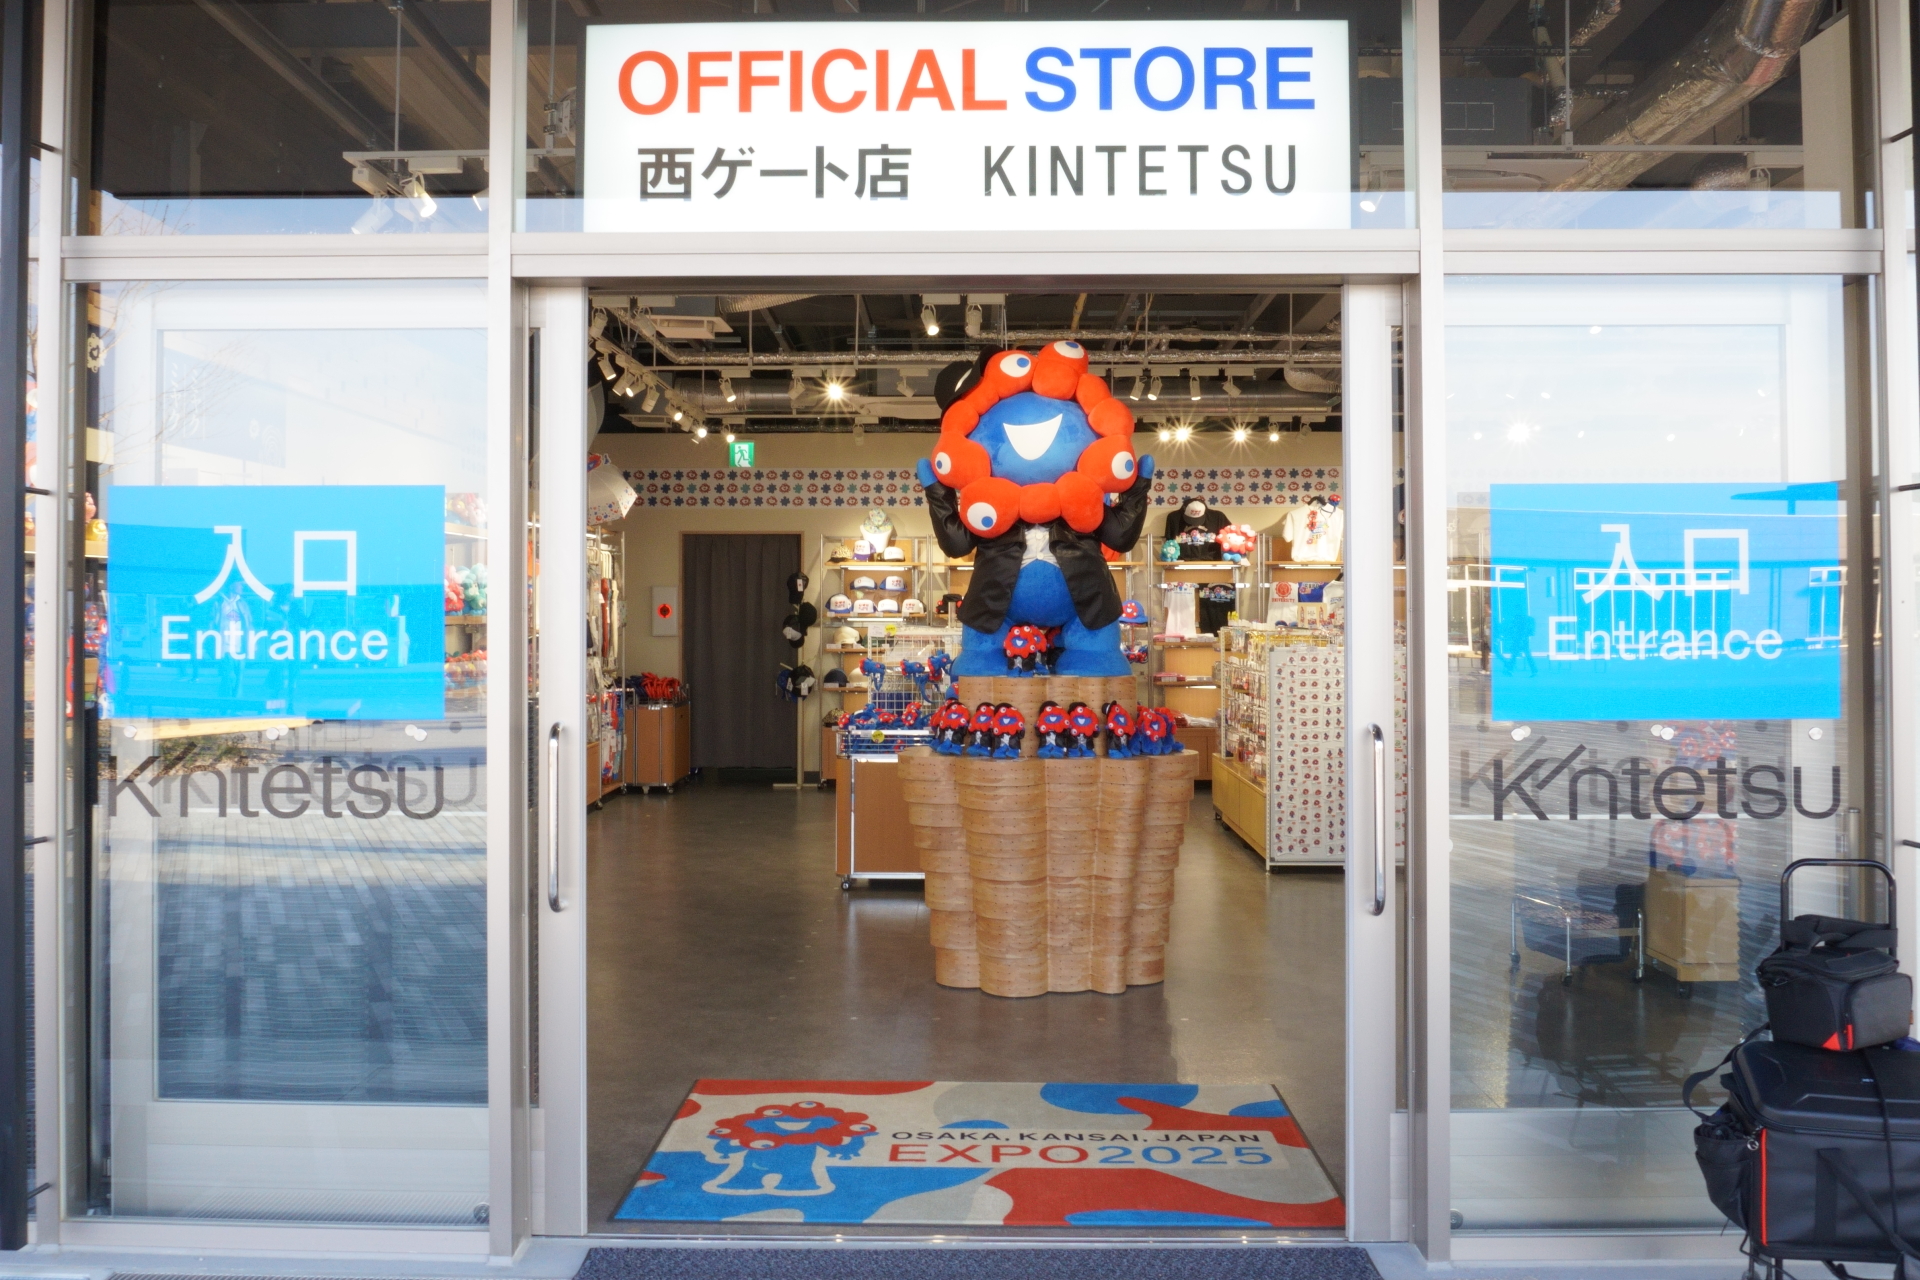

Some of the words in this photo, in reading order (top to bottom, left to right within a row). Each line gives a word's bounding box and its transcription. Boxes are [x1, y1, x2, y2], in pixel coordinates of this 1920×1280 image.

[617, 48, 1008, 116] OFFICIAL
[1024, 45, 1315, 112] STORE
[637, 144, 913, 200] 西ゲート店
[984, 144, 1297, 197] KINTETSU
[194, 525, 357, 605] 入口
[1582, 523, 1751, 605] 入口
[162, 615, 389, 661] Entrance
[1548, 616, 1784, 661] Entrance
[108, 741, 446, 819] Kintetsu
[1494, 743, 1841, 821] Kintetsu
[888, 1143, 1273, 1165] EXPO2025
[1157, 1134, 1261, 1143] JAPAN
